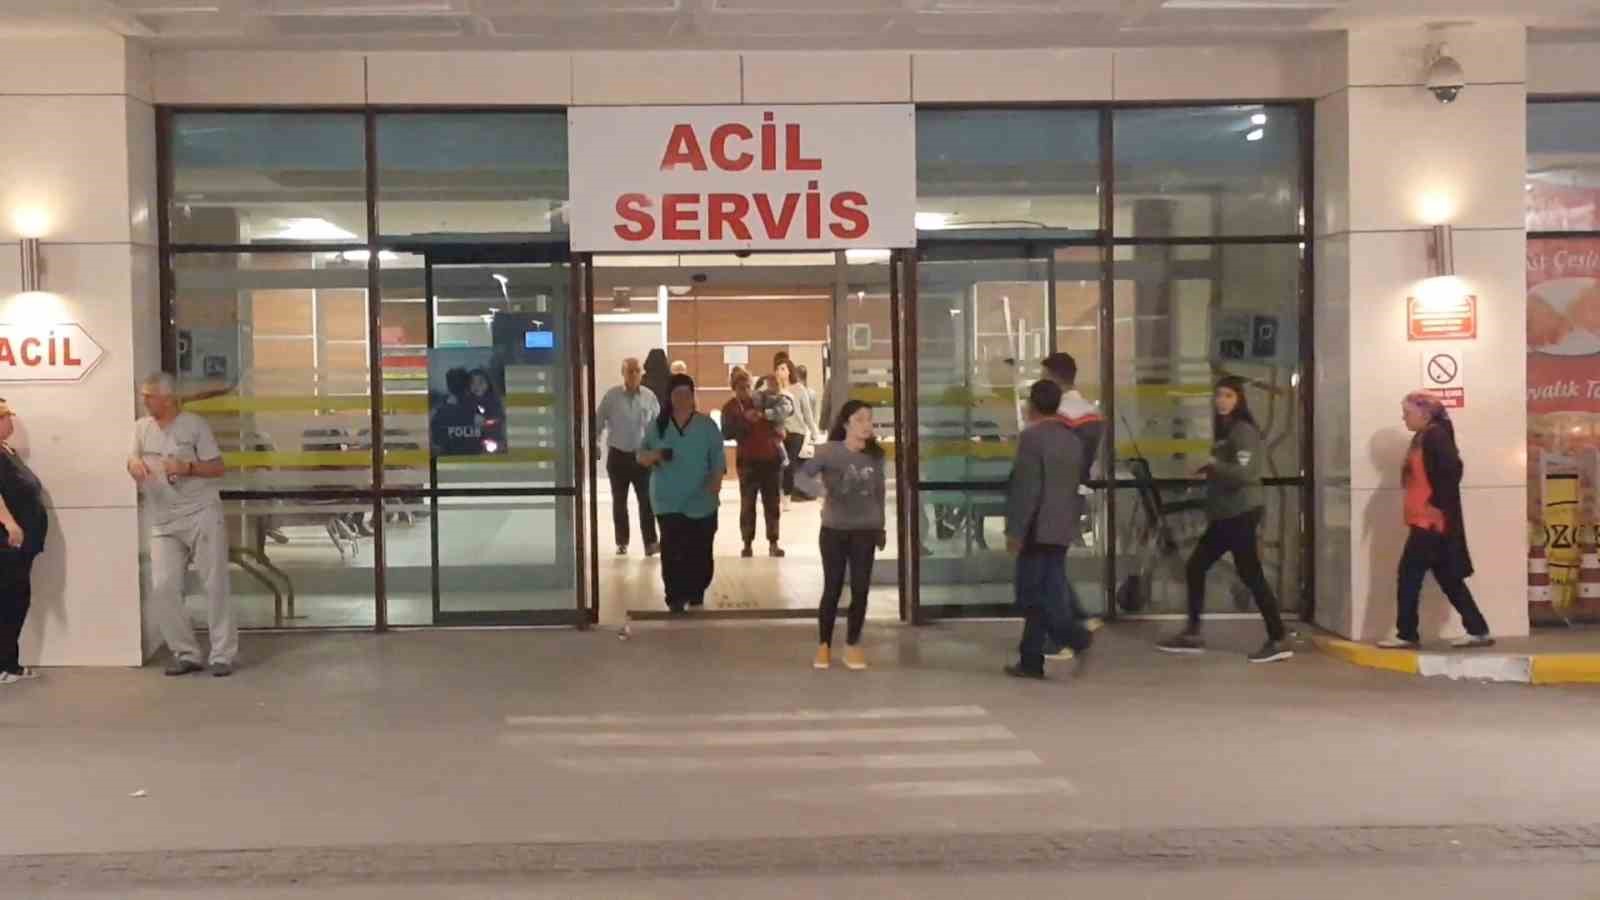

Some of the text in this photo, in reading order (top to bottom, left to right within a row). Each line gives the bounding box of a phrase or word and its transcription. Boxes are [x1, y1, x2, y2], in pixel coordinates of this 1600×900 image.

[660, 111, 822, 171] ACİL
[614, 180, 870, 241] SERVİS
[0, 330, 81, 366] ACİL
